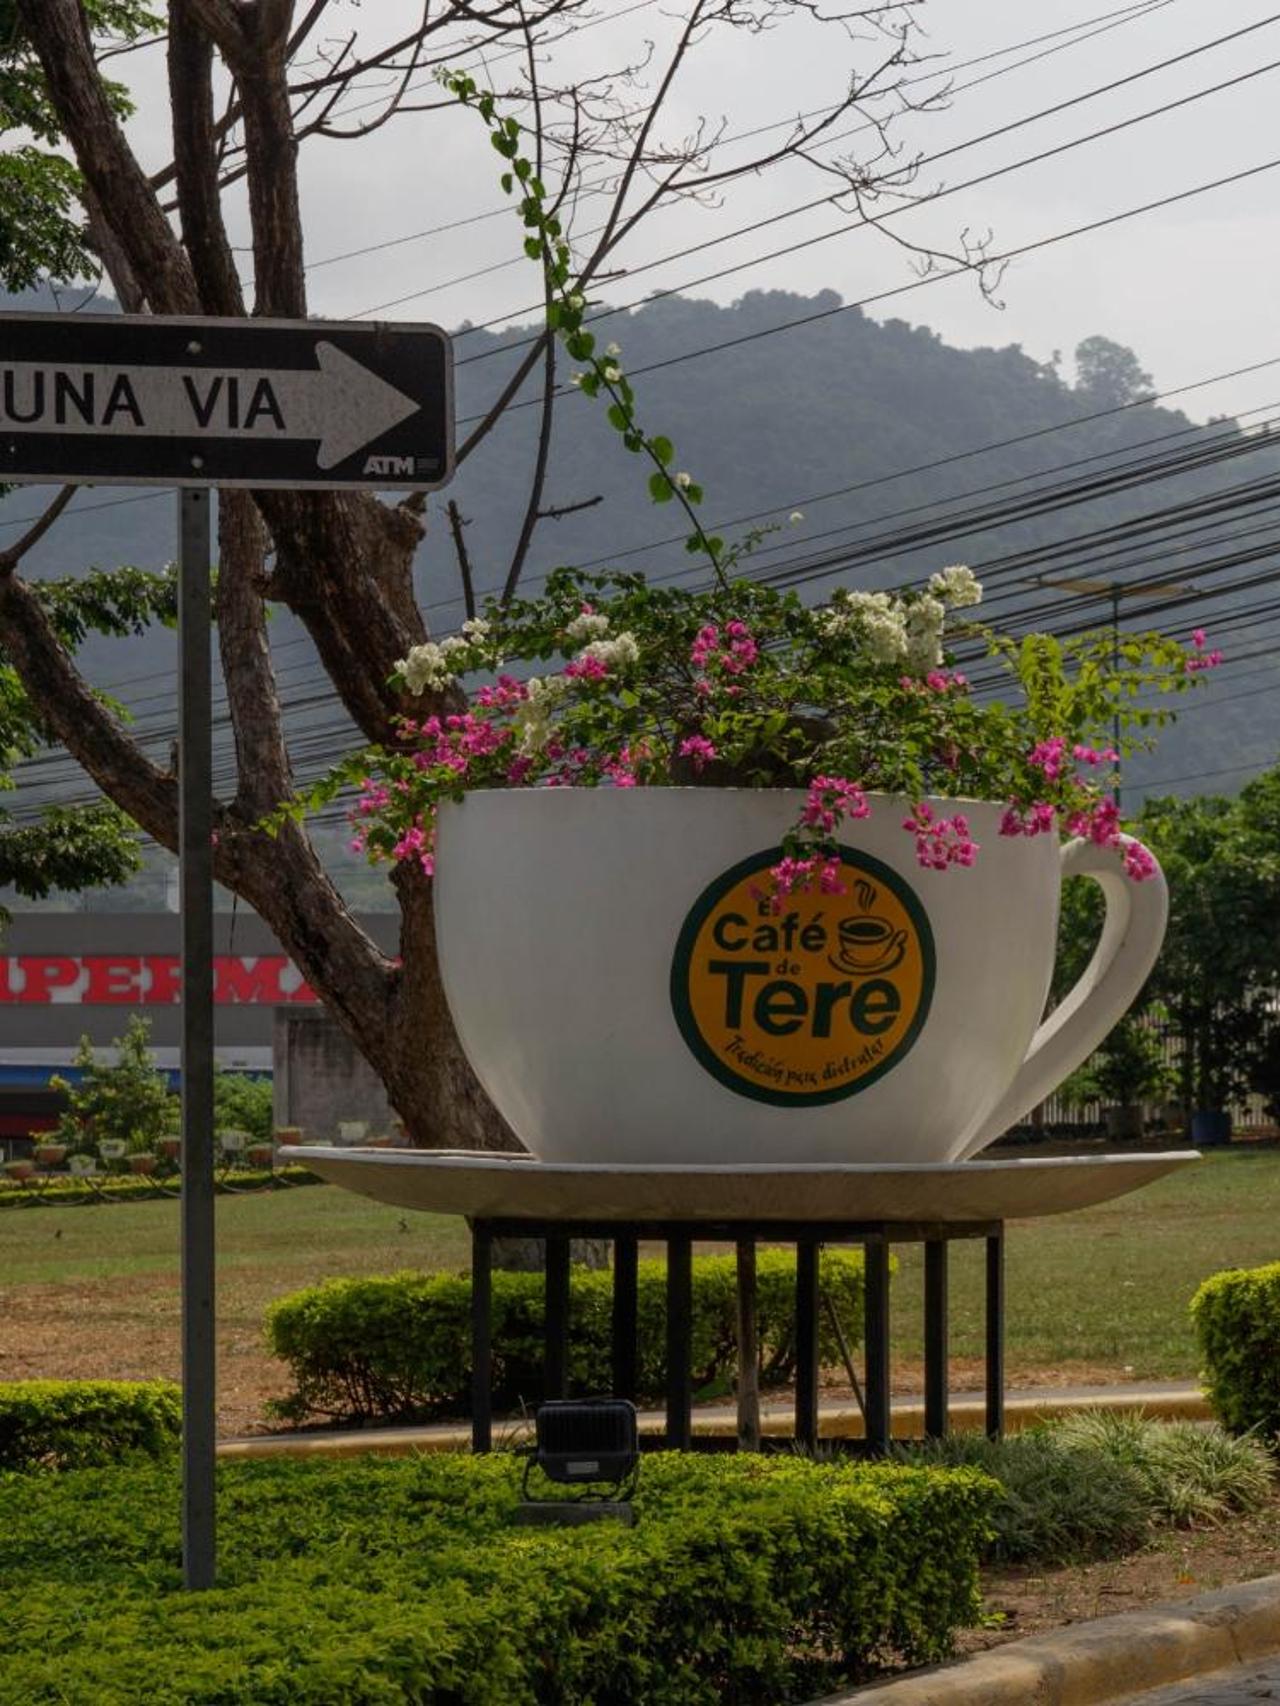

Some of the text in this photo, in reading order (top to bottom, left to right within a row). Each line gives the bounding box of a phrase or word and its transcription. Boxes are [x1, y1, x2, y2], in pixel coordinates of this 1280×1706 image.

[4, 370, 287, 430] UNA VIA
[362, 455, 416, 476] ATM
[757, 896, 780, 916] E
[713, 911, 828, 952] Café
[0, 955, 325, 1004] PERM
[776, 958, 801, 976] de
[708, 960, 900, 1039] Tere
